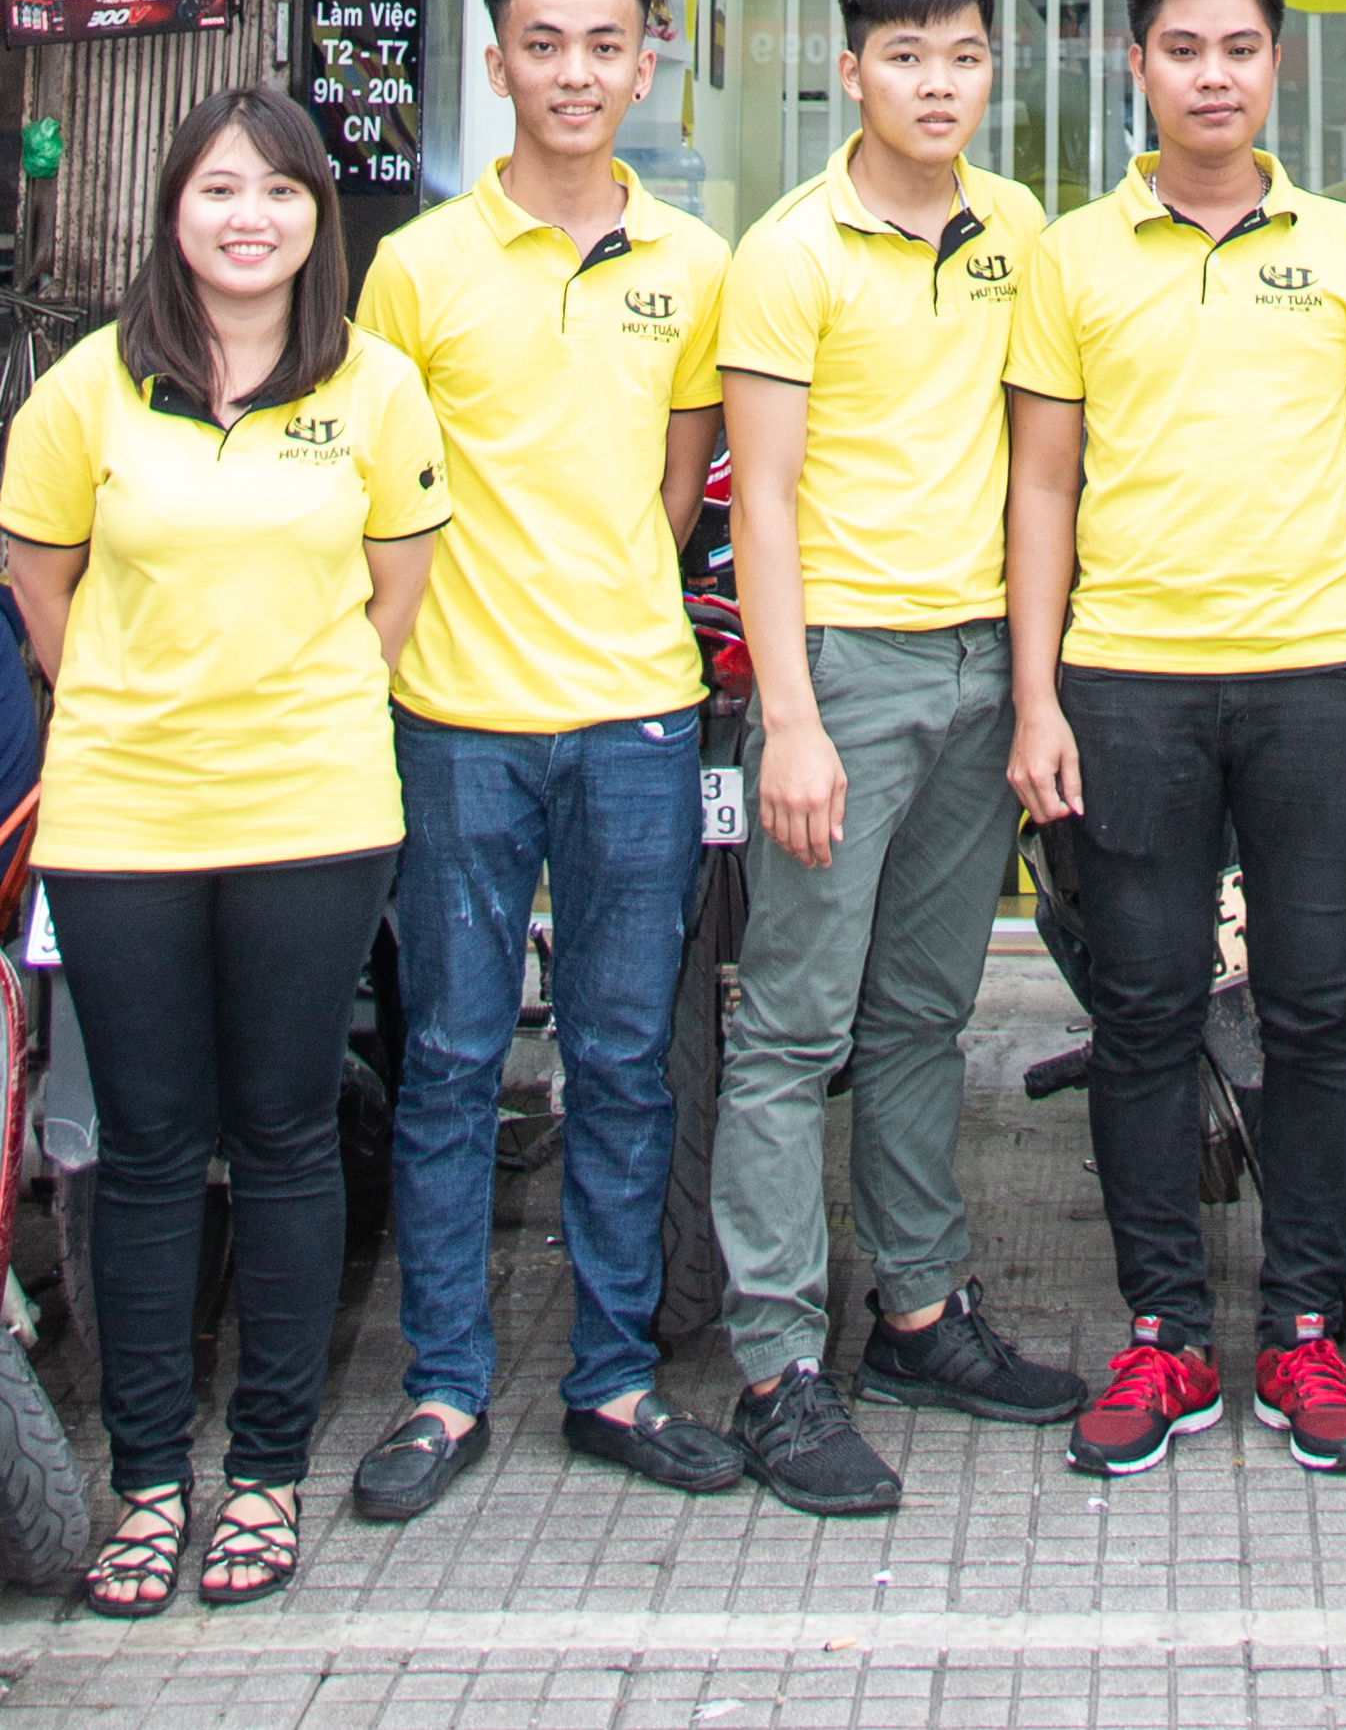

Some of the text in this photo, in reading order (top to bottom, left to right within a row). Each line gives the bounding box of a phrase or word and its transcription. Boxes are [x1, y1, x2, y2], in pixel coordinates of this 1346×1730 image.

[316, 1, 417, 32] Làm Việc
[322, 39, 354, 65] T2
[313, 78, 344, 103] 9h
[367, 78, 414, 104] 20h
[343, 115, 382, 142] CN
[326, 155, 341, 180] h
[366, 155, 411, 181] 15h
[1255, 294, 1284, 306] HUY
[622, 322, 649, 334] HUY
[278, 446, 309, 461] HUY
[702, 805, 736, 835] 9
